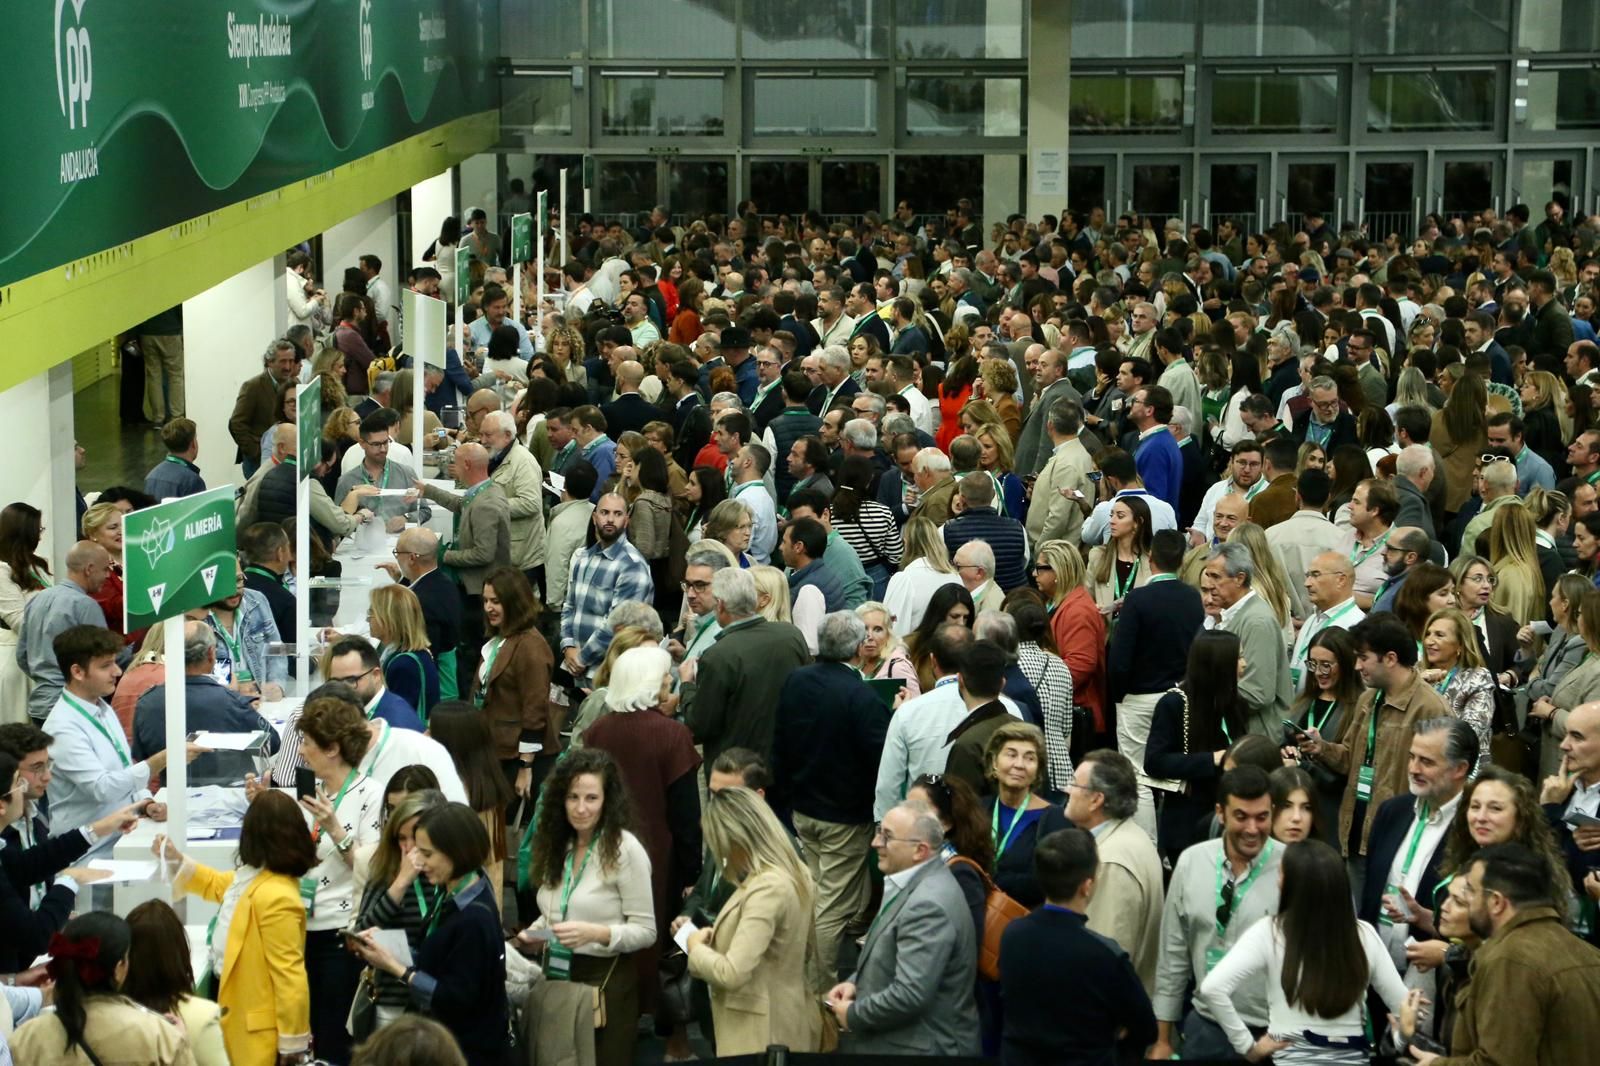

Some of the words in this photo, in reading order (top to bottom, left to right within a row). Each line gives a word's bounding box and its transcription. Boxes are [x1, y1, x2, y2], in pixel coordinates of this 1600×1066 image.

[227, 11, 259, 67] Siempre
[60, 141, 99, 184] ANDALUCÍA
[184, 512, 222, 541] ALMERÍA
